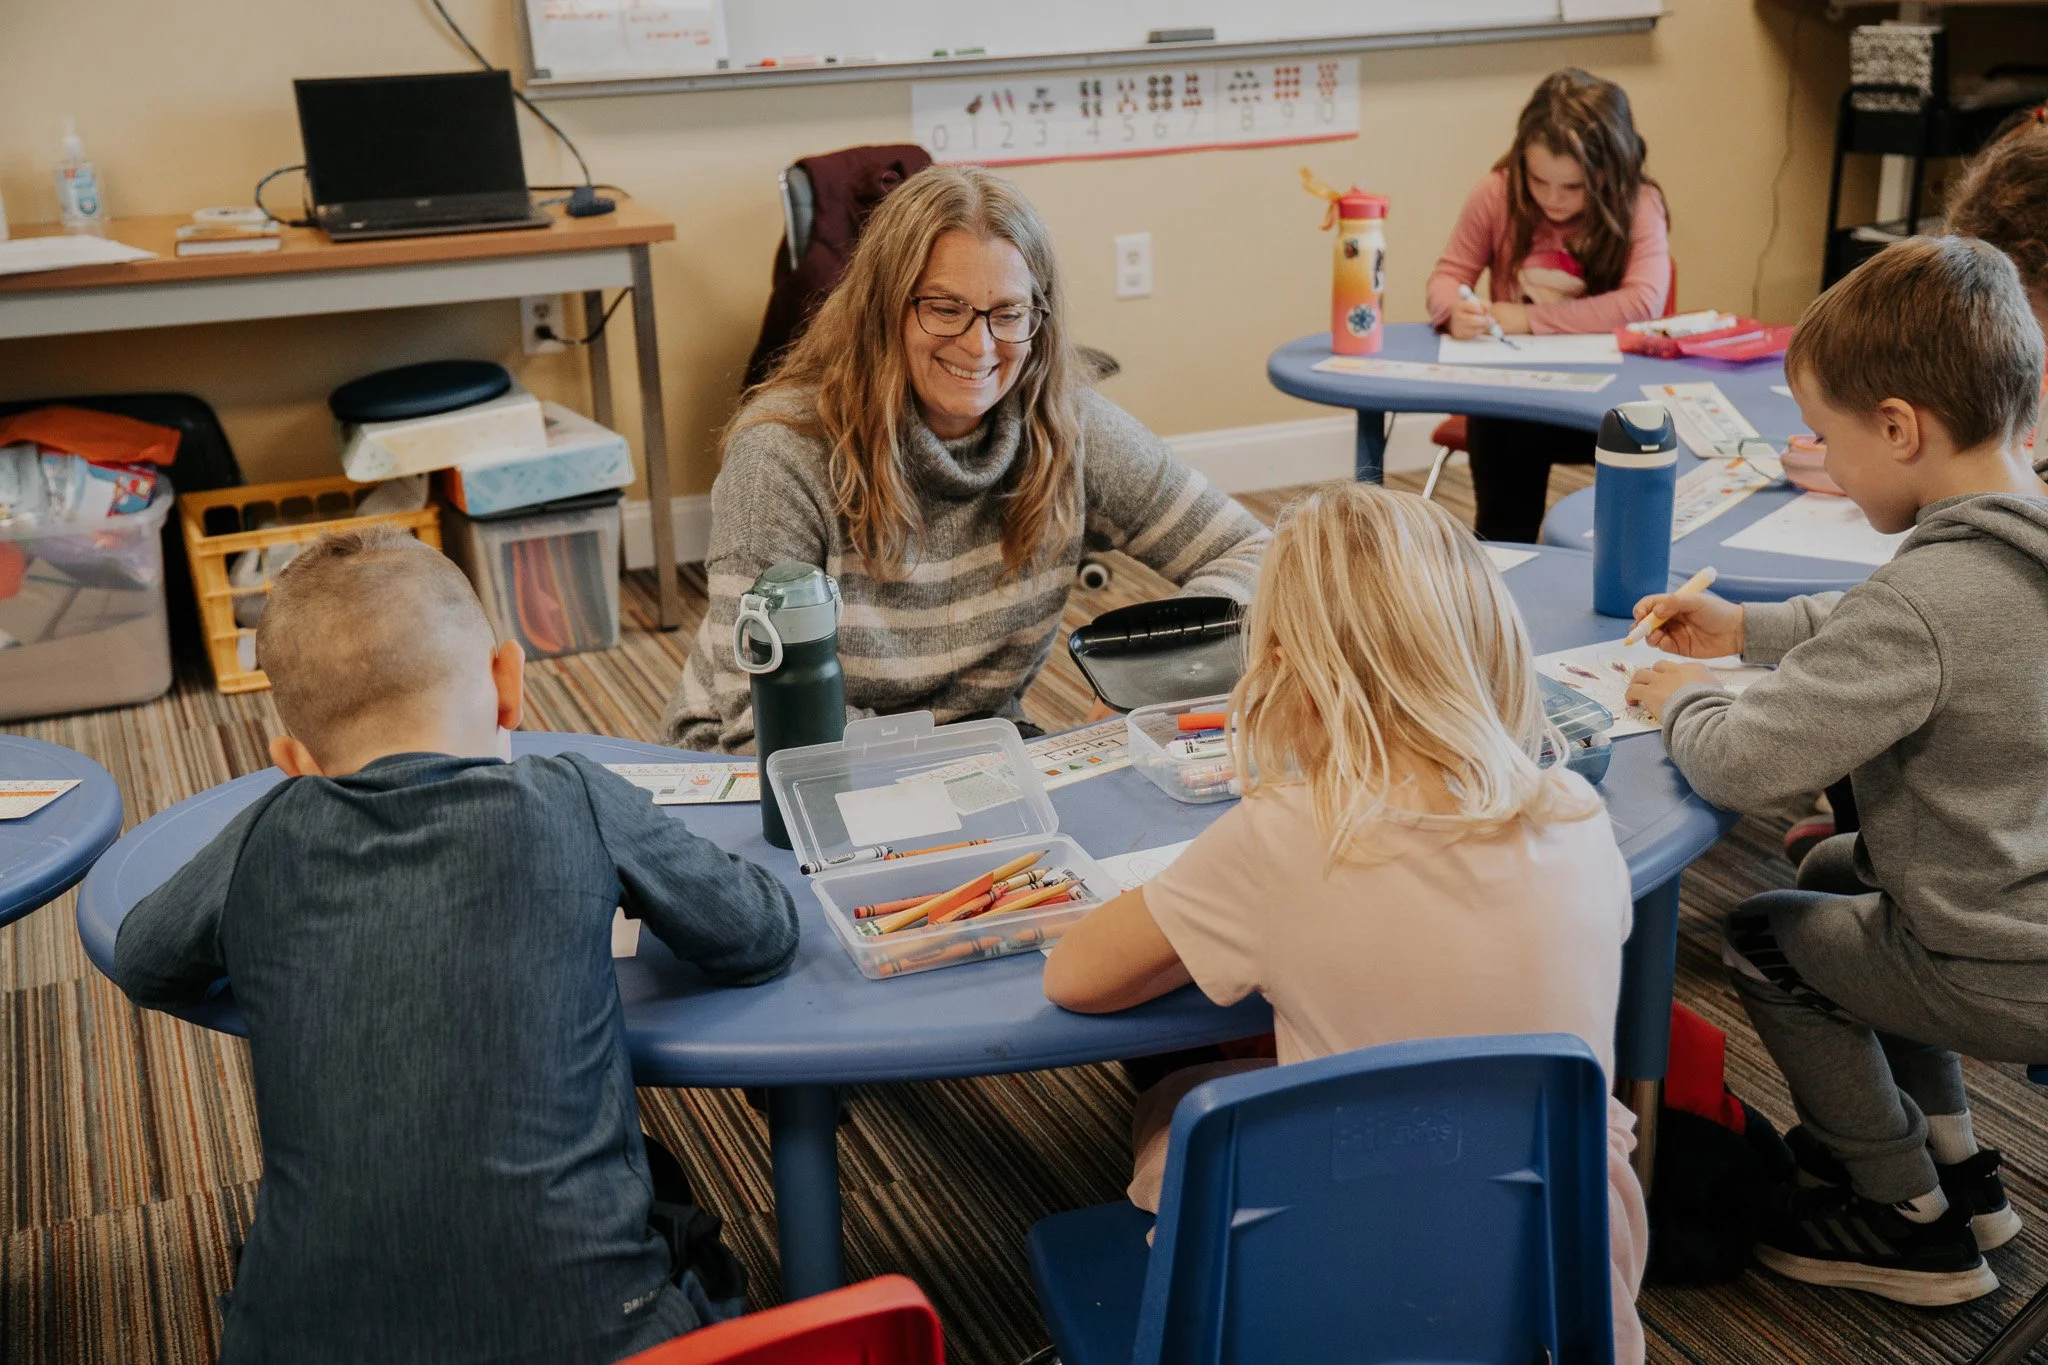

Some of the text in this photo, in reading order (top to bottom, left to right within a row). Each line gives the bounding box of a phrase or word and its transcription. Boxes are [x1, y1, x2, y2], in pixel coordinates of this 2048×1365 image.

[932, 123, 948, 151] 0
[1001, 120, 1014, 149] 2
[1034, 118, 1047, 147] 3
[1085, 113, 1101, 143] 4
[1122, 114, 1136, 142] 5
[1153, 111, 1168, 140] 6
[1183, 106, 1200, 137] 7
[1240, 103, 1254, 131] 8
[1281, 100, 1295, 129] 9
[1043, 739, 1123, 761] Everley
